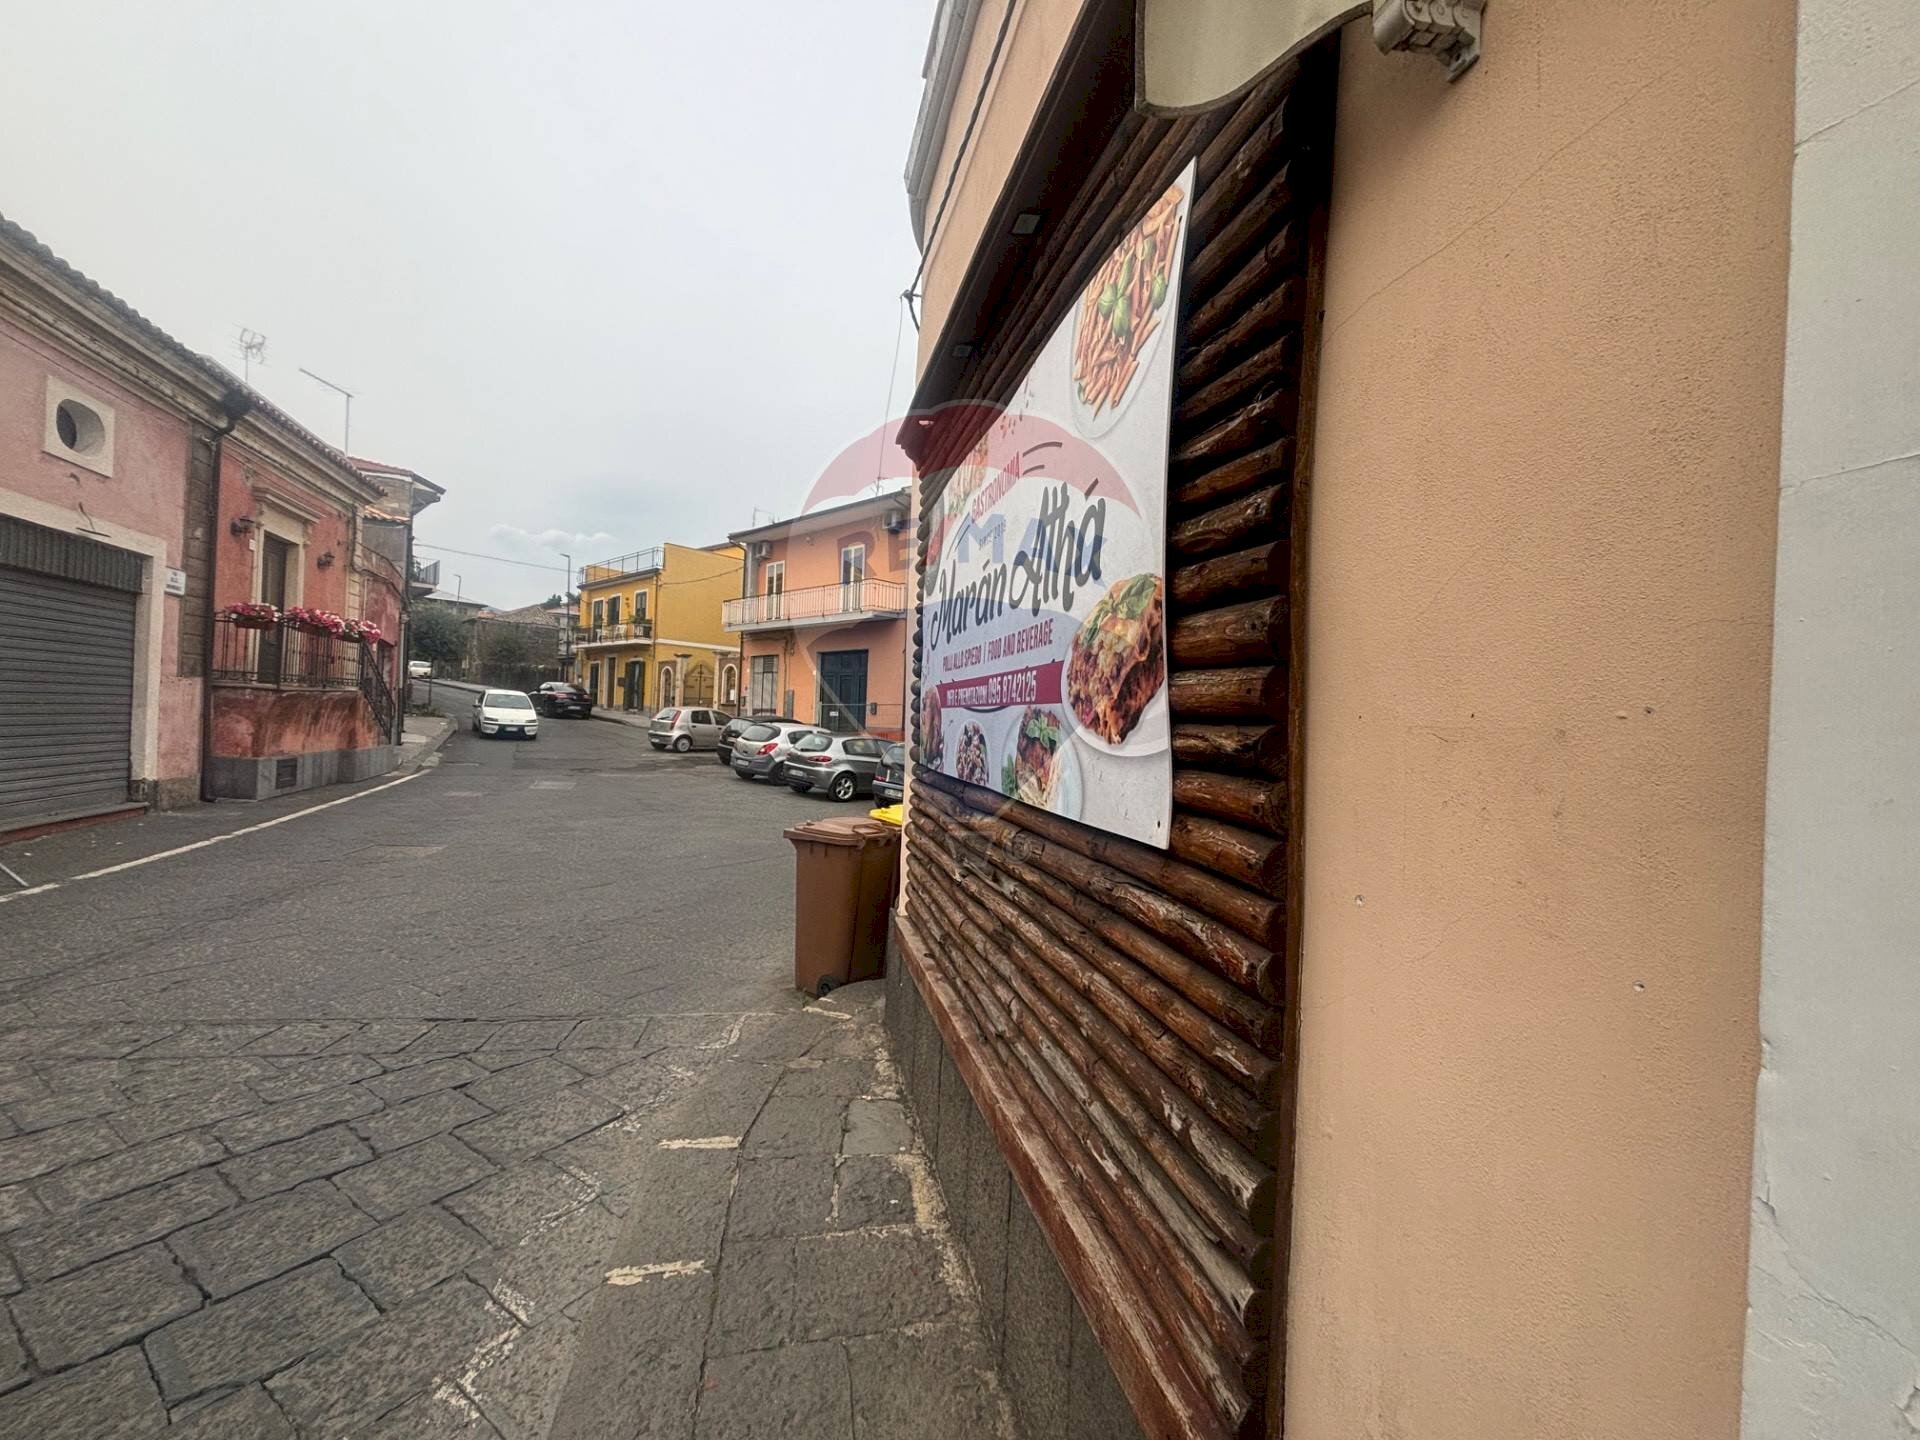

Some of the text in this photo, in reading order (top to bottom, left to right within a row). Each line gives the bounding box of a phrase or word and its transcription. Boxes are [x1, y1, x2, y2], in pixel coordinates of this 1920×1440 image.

[971, 451, 1020, 524] GASTRONOMIA
[964, 644, 981, 668] SPIEDO
[988, 637, 1001, 661] FOOD
[1002, 633, 1015, 658] AND
[1016, 618, 1053, 653] BEVERAGE
[1002, 670, 1036, 703] 8742125
